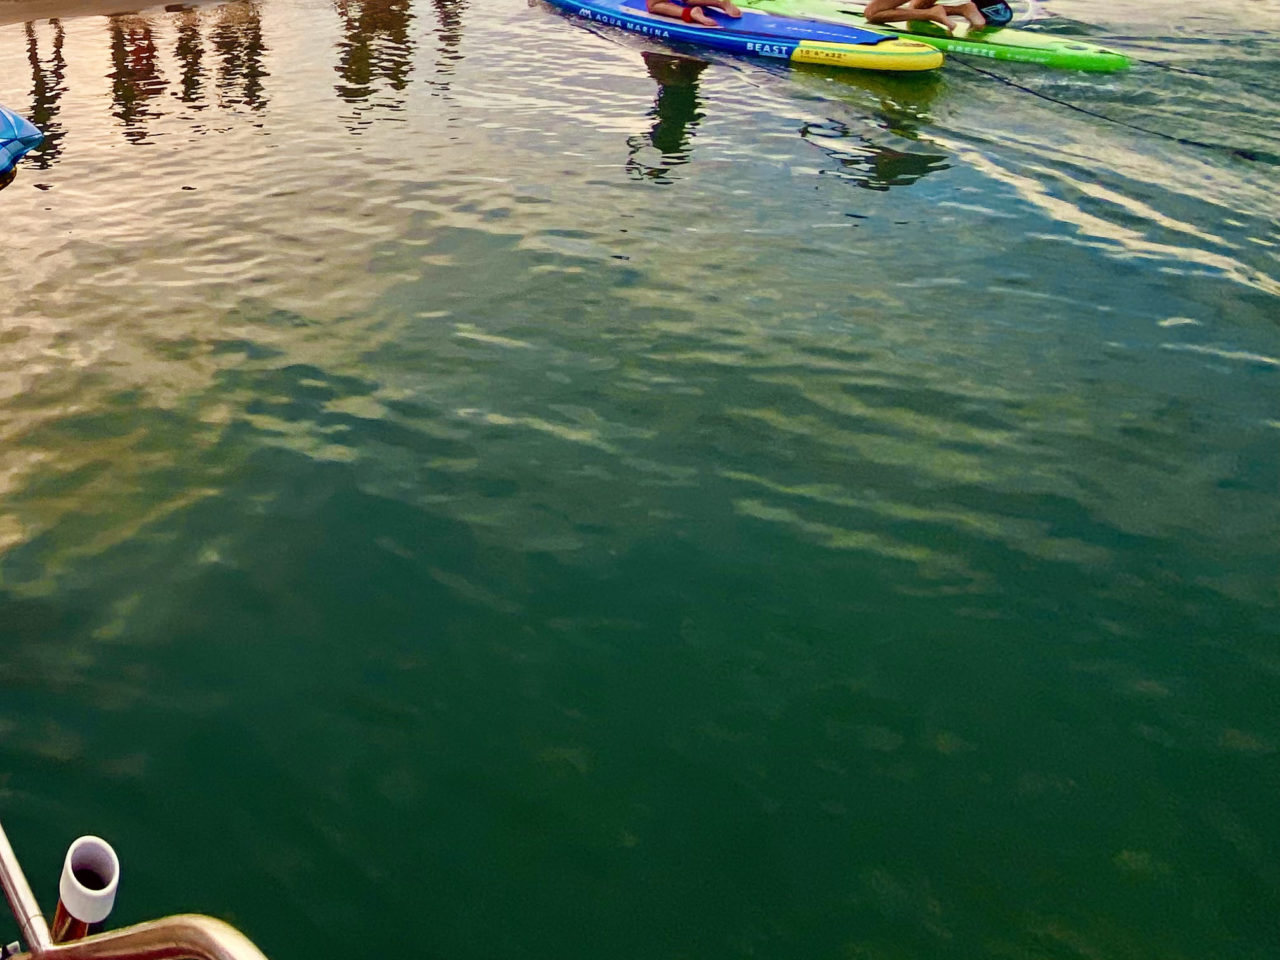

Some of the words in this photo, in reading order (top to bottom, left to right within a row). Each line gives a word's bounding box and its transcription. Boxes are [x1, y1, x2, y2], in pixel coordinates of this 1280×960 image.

[595, 14, 622, 27] AQUA
[626, 22, 670, 38] MARINA
[746, 42, 788, 54] BEAST
